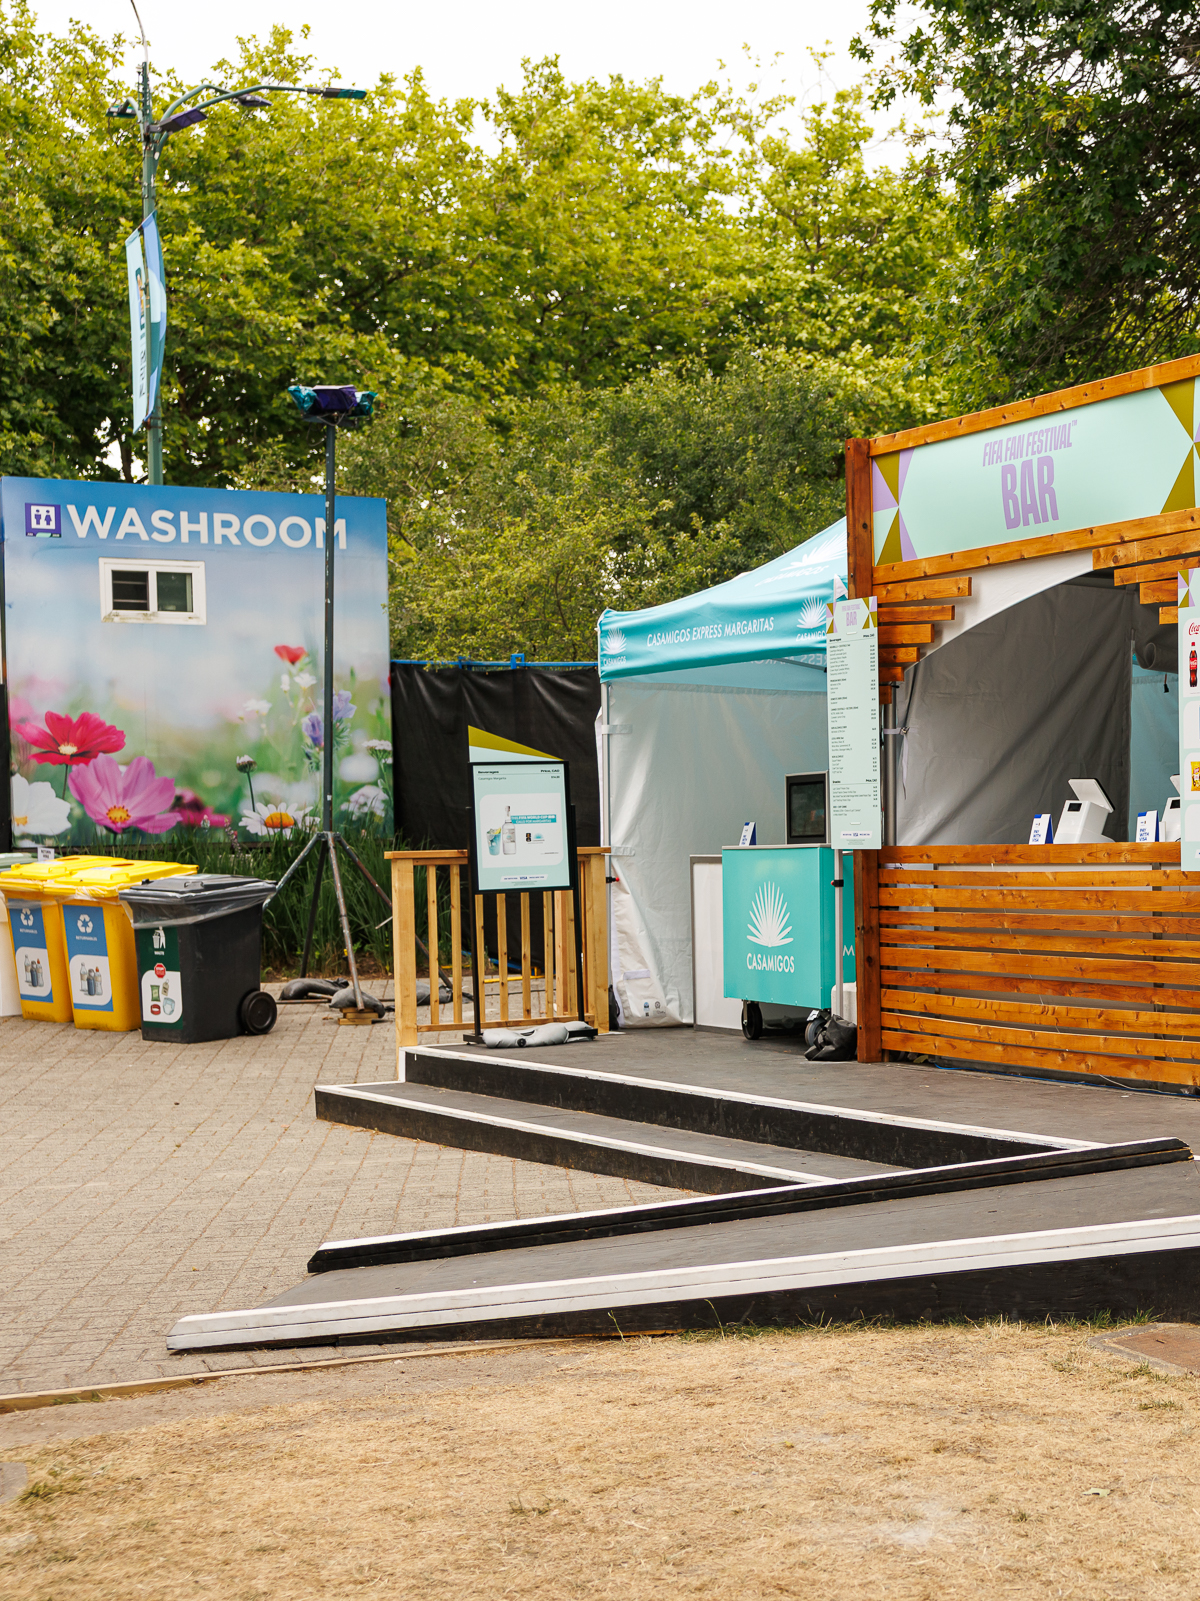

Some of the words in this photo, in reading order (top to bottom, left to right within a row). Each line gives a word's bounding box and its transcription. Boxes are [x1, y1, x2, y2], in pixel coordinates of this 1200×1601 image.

[982, 439, 1003, 467] FIFA
[1004, 434, 1025, 462] FAN
[1002, 455, 1059, 530] BAR
[66, 504, 347, 550] WASHROOM
[846, 611, 857, 626] BAR
[647, 628, 690, 647] CASAMIGOS
[692, 624, 722, 640] EXPRESS
[724, 617, 774, 637] MARGARITAS
[796, 630, 826, 641] CASAMIGO
[603, 656, 626, 667] CASAMIGOS
[746, 952, 794, 974] CASAMIGOS
